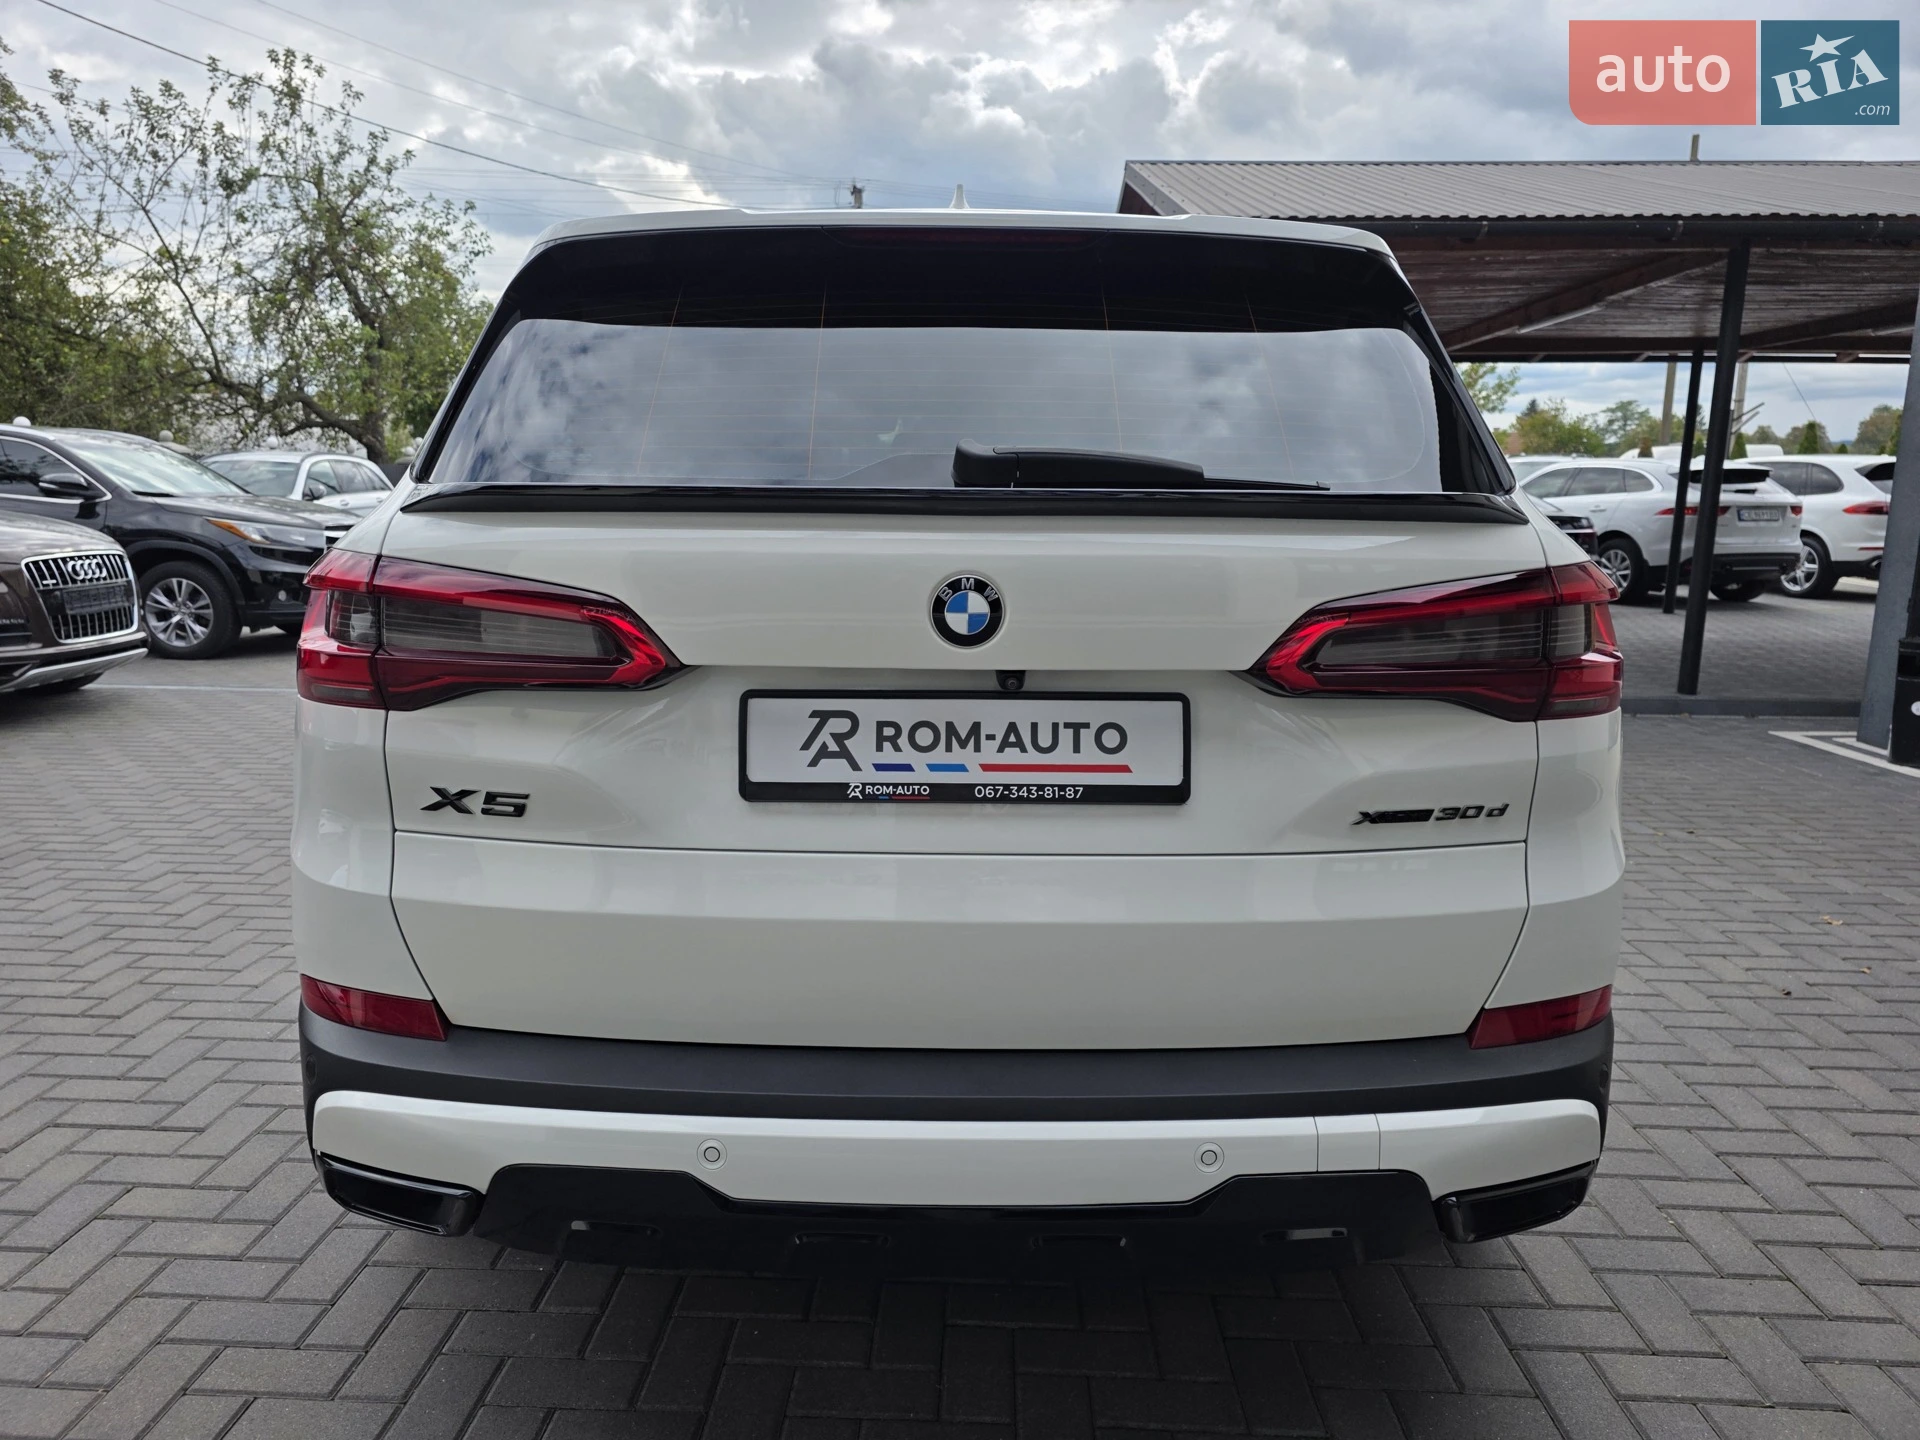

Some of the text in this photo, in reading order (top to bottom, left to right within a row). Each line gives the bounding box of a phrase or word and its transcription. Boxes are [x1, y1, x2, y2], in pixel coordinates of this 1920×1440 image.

[938, 577, 999, 602] BMW
[875, 720, 1129, 755] ROM-AUTO
[420, 786, 531, 818] X5
[865, 785, 930, 795] ROM-AUTO
[974, 786, 1084, 799] 067-343-81-87
